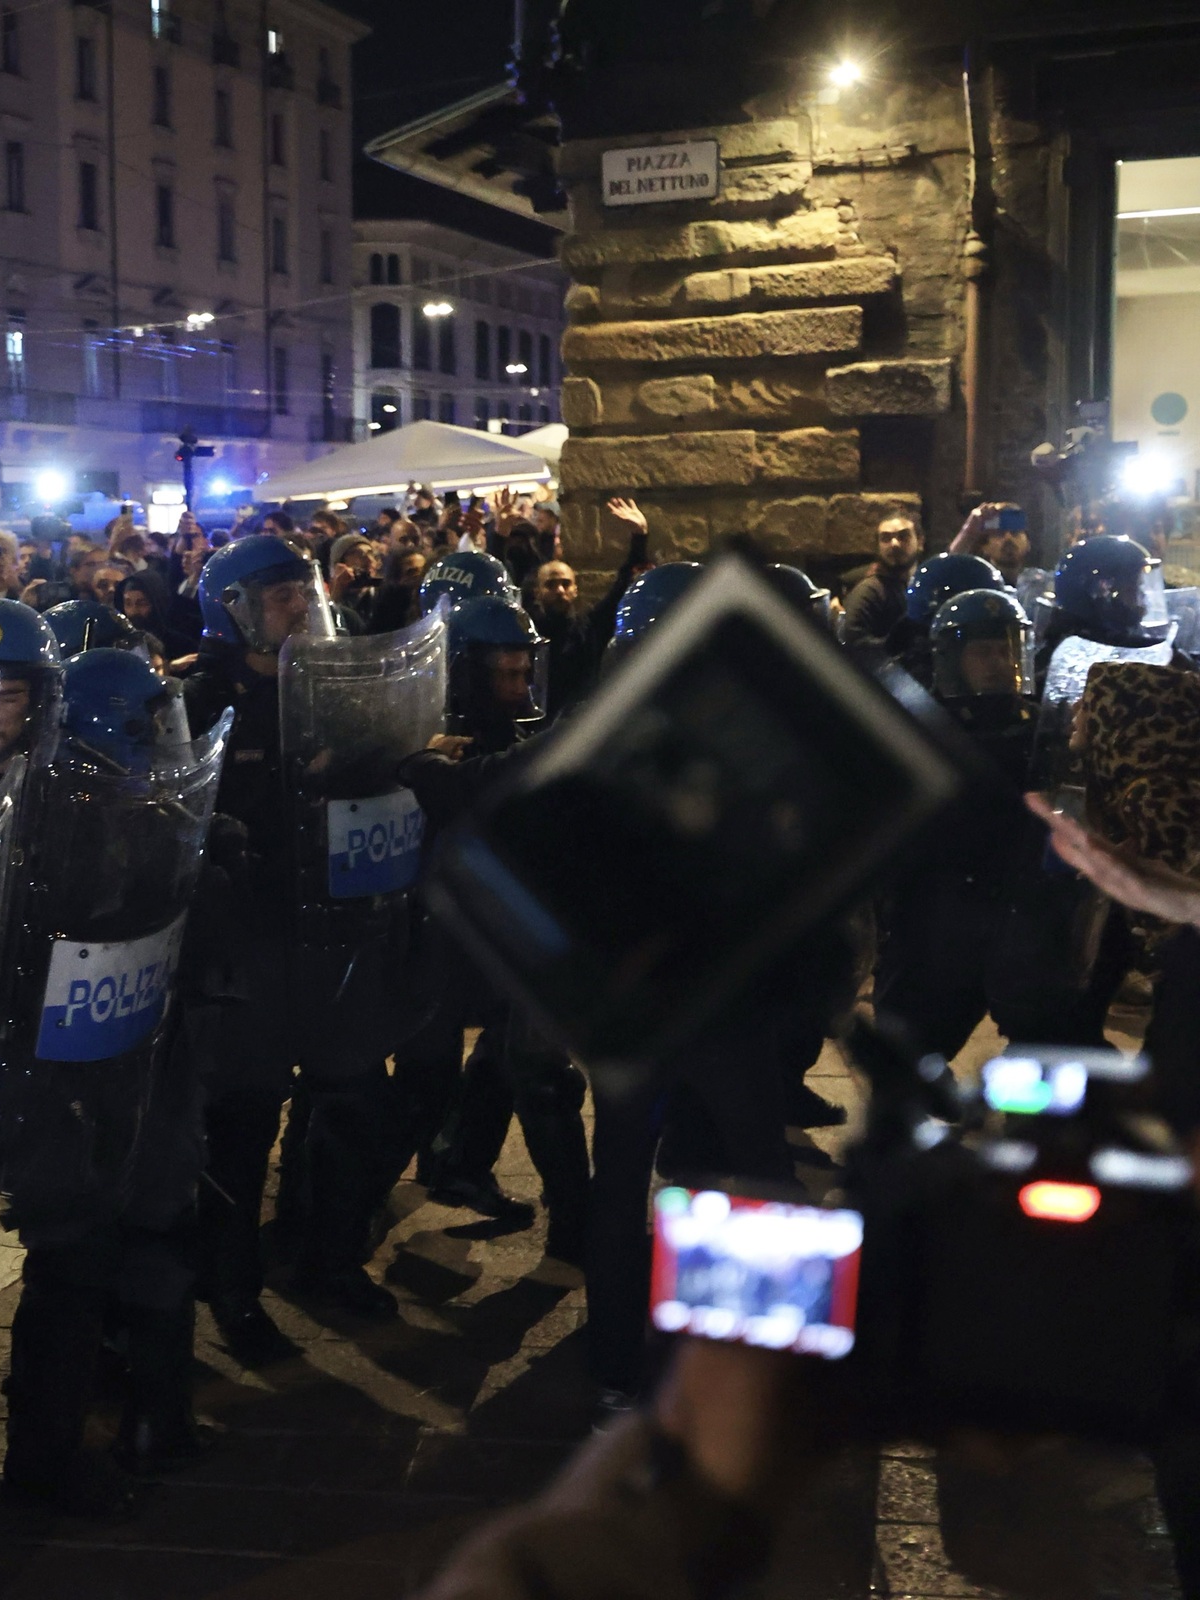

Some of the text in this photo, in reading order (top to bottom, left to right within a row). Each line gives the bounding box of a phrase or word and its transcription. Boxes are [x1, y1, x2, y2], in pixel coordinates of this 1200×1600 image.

[627, 152, 691, 173] PIAZZA
[423, 566, 475, 589] OLIZIA
[347, 808, 423, 870] POLIZ
